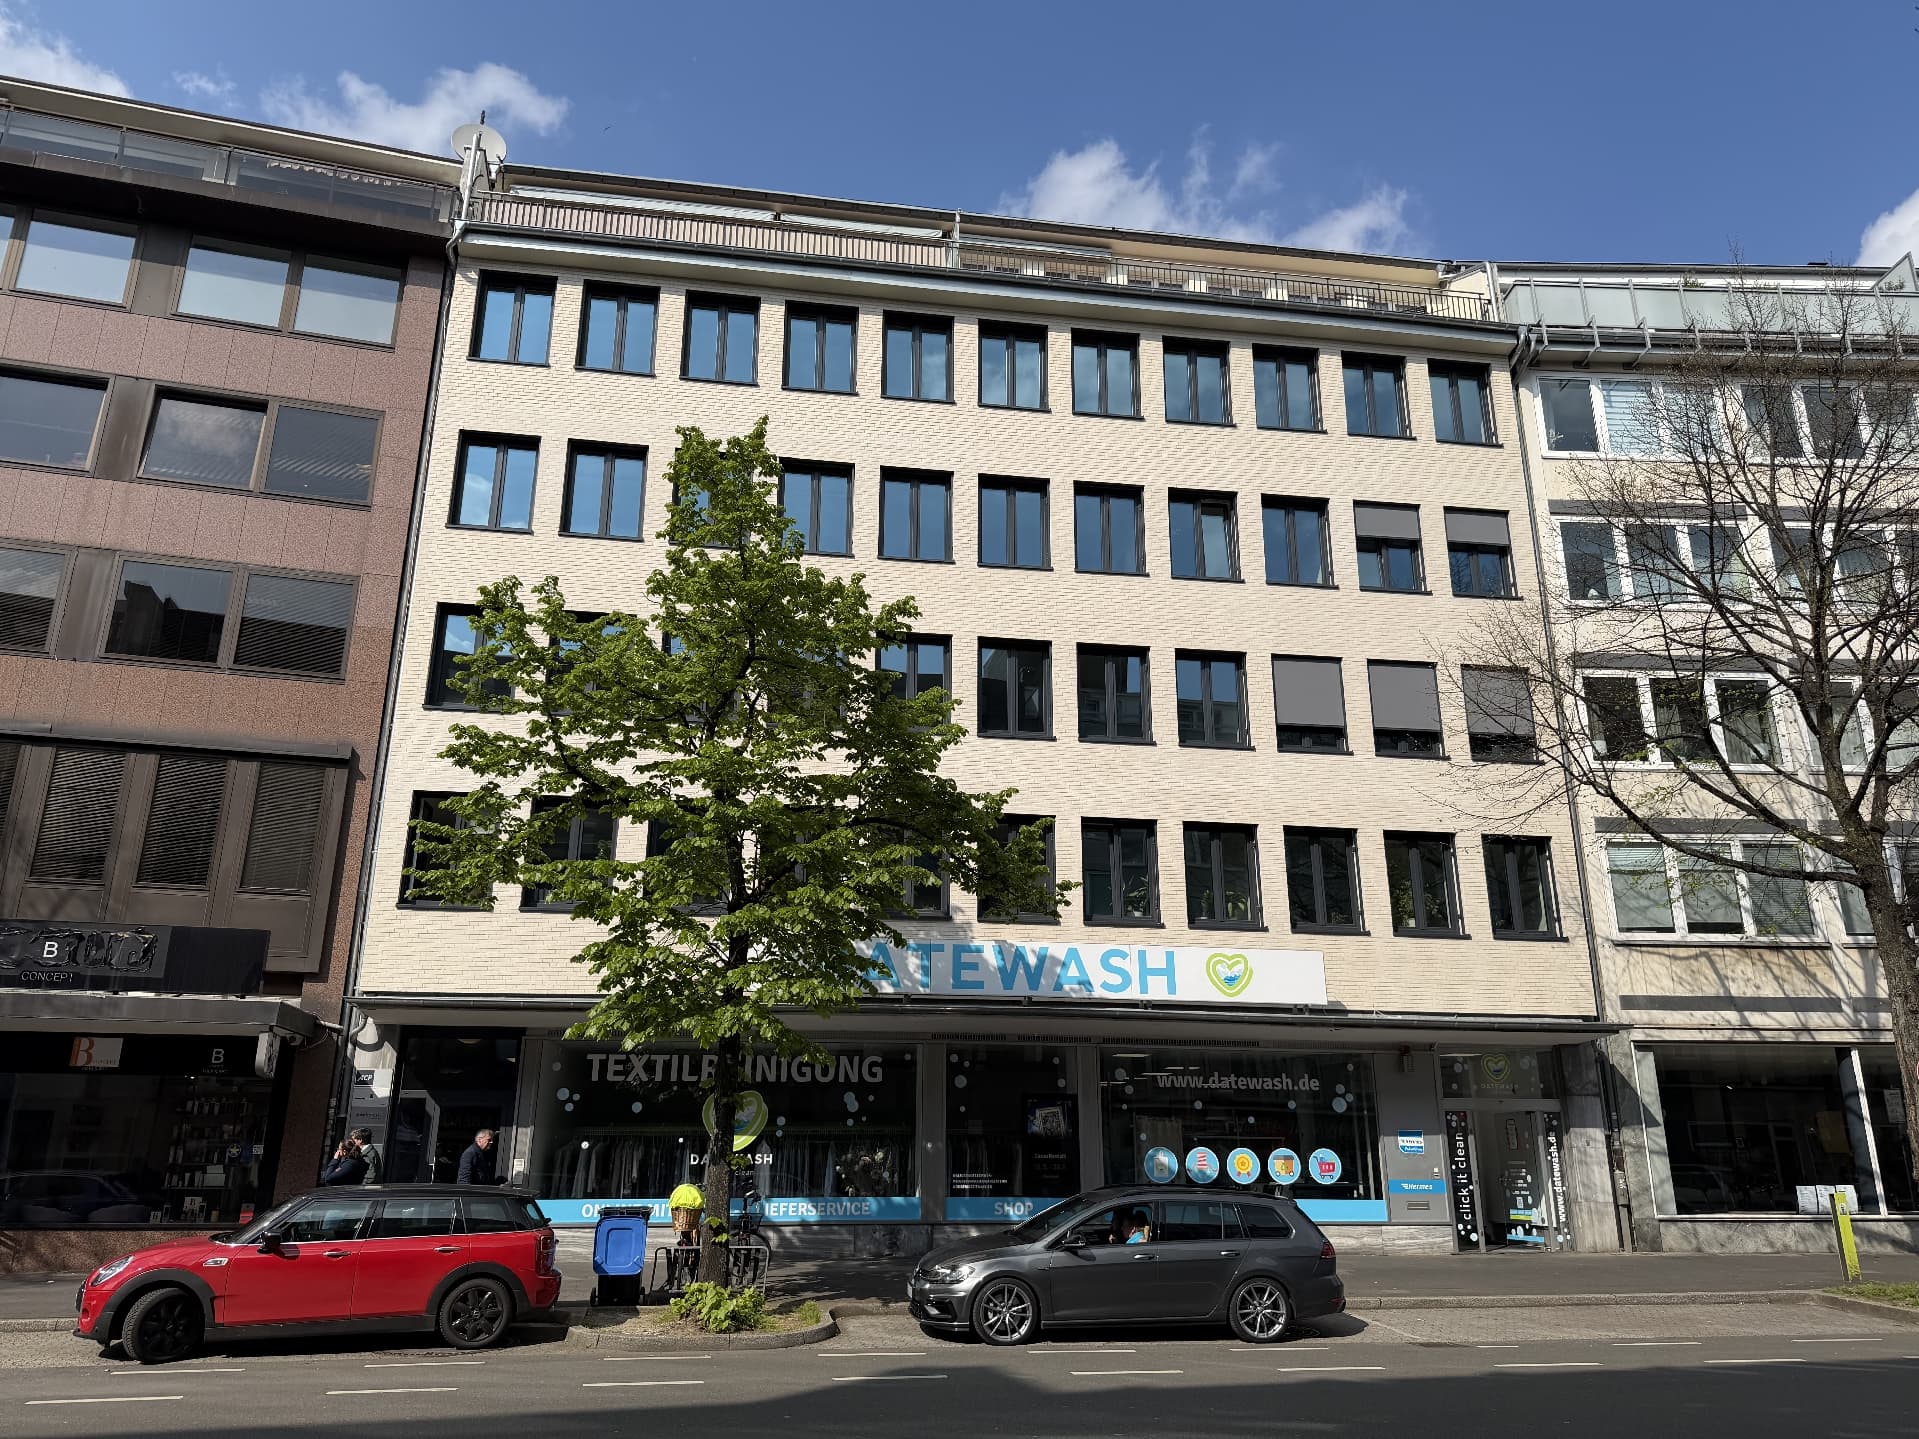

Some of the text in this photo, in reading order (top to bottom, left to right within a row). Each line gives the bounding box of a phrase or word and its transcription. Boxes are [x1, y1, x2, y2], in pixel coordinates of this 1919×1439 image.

[42, 941, 59, 958] B
[843, 941, 1177, 996] ATEWASH
[211, 1048, 225, 1064] B
[1156, 1071, 1320, 1091] www.datewash.de
[1454, 1132, 1472, 1221] click it clean
[1547, 1131, 1567, 1223] www.datewash.de
[757, 1201, 871, 1217] IEFERSERVICE
[994, 1202, 1034, 1216] SHOP
